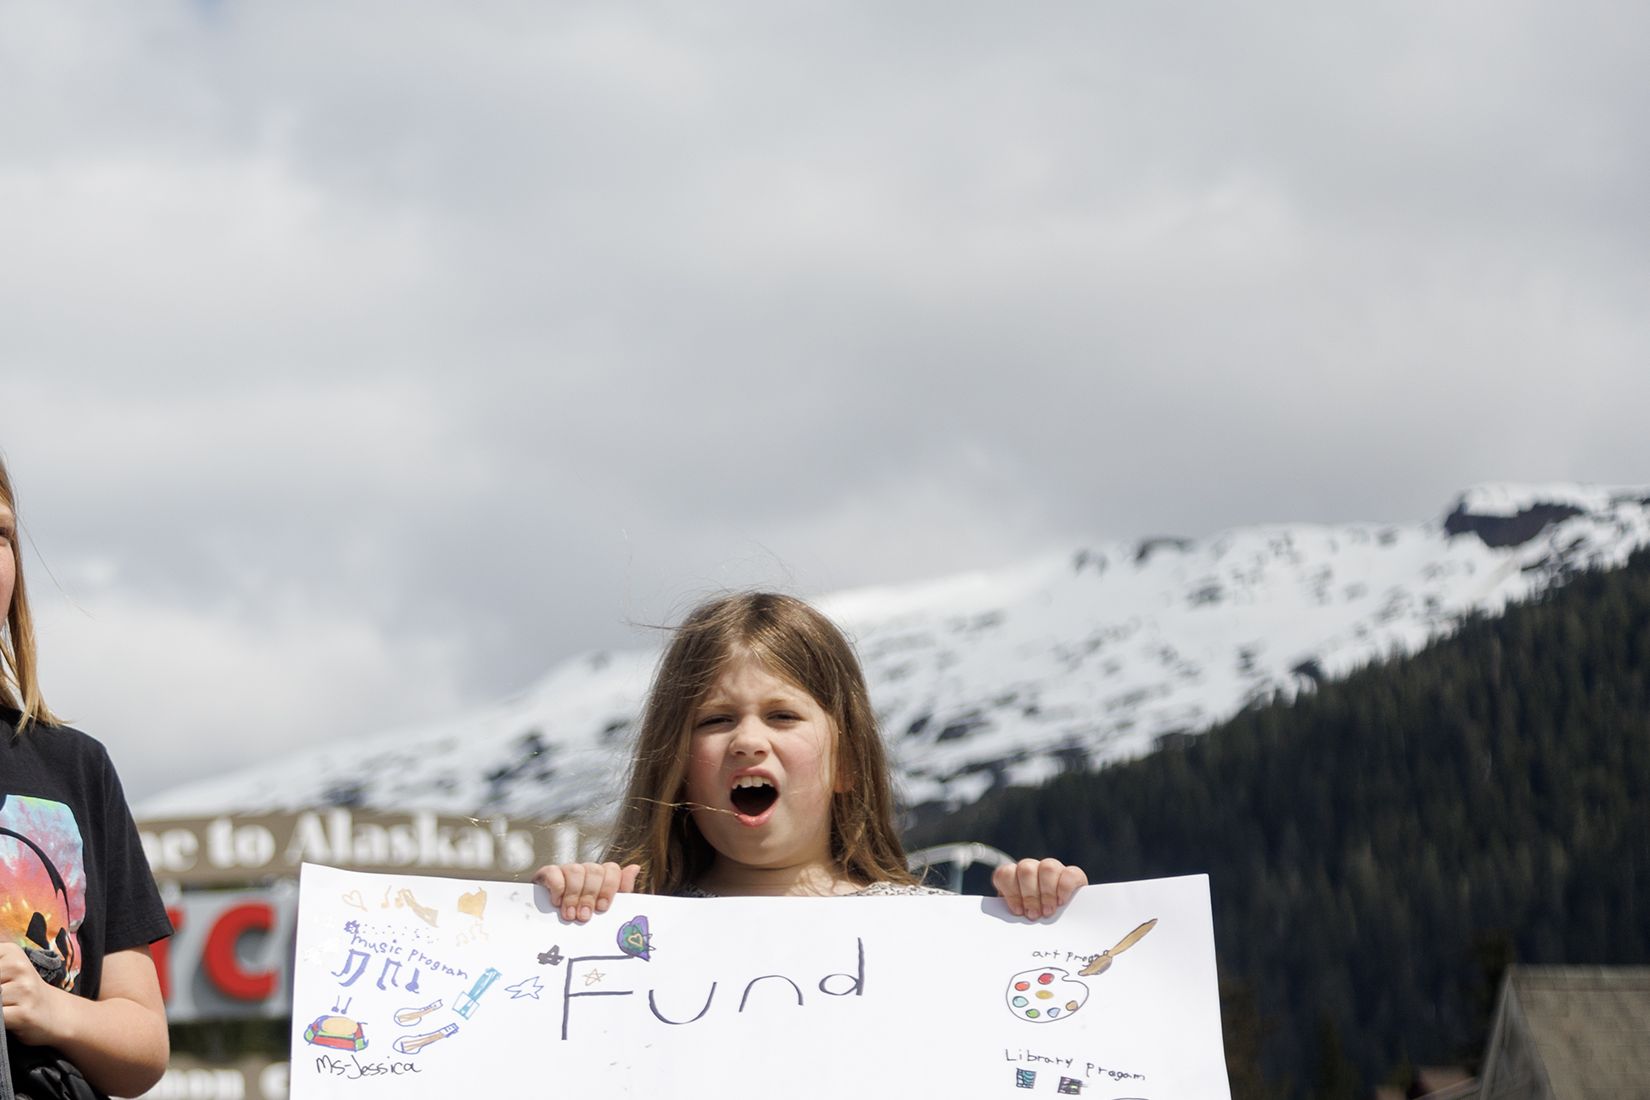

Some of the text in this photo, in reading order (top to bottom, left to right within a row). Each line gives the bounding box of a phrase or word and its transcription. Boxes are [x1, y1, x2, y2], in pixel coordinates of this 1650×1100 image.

[206, 815, 276, 869] to
[285, 808, 535, 872] Alaska's
[351, 933, 403, 955] music
[1032, 949, 1061, 960] art
[560, 937, 866, 1041] Fund
[1005, 1048, 1074, 1068] Library
